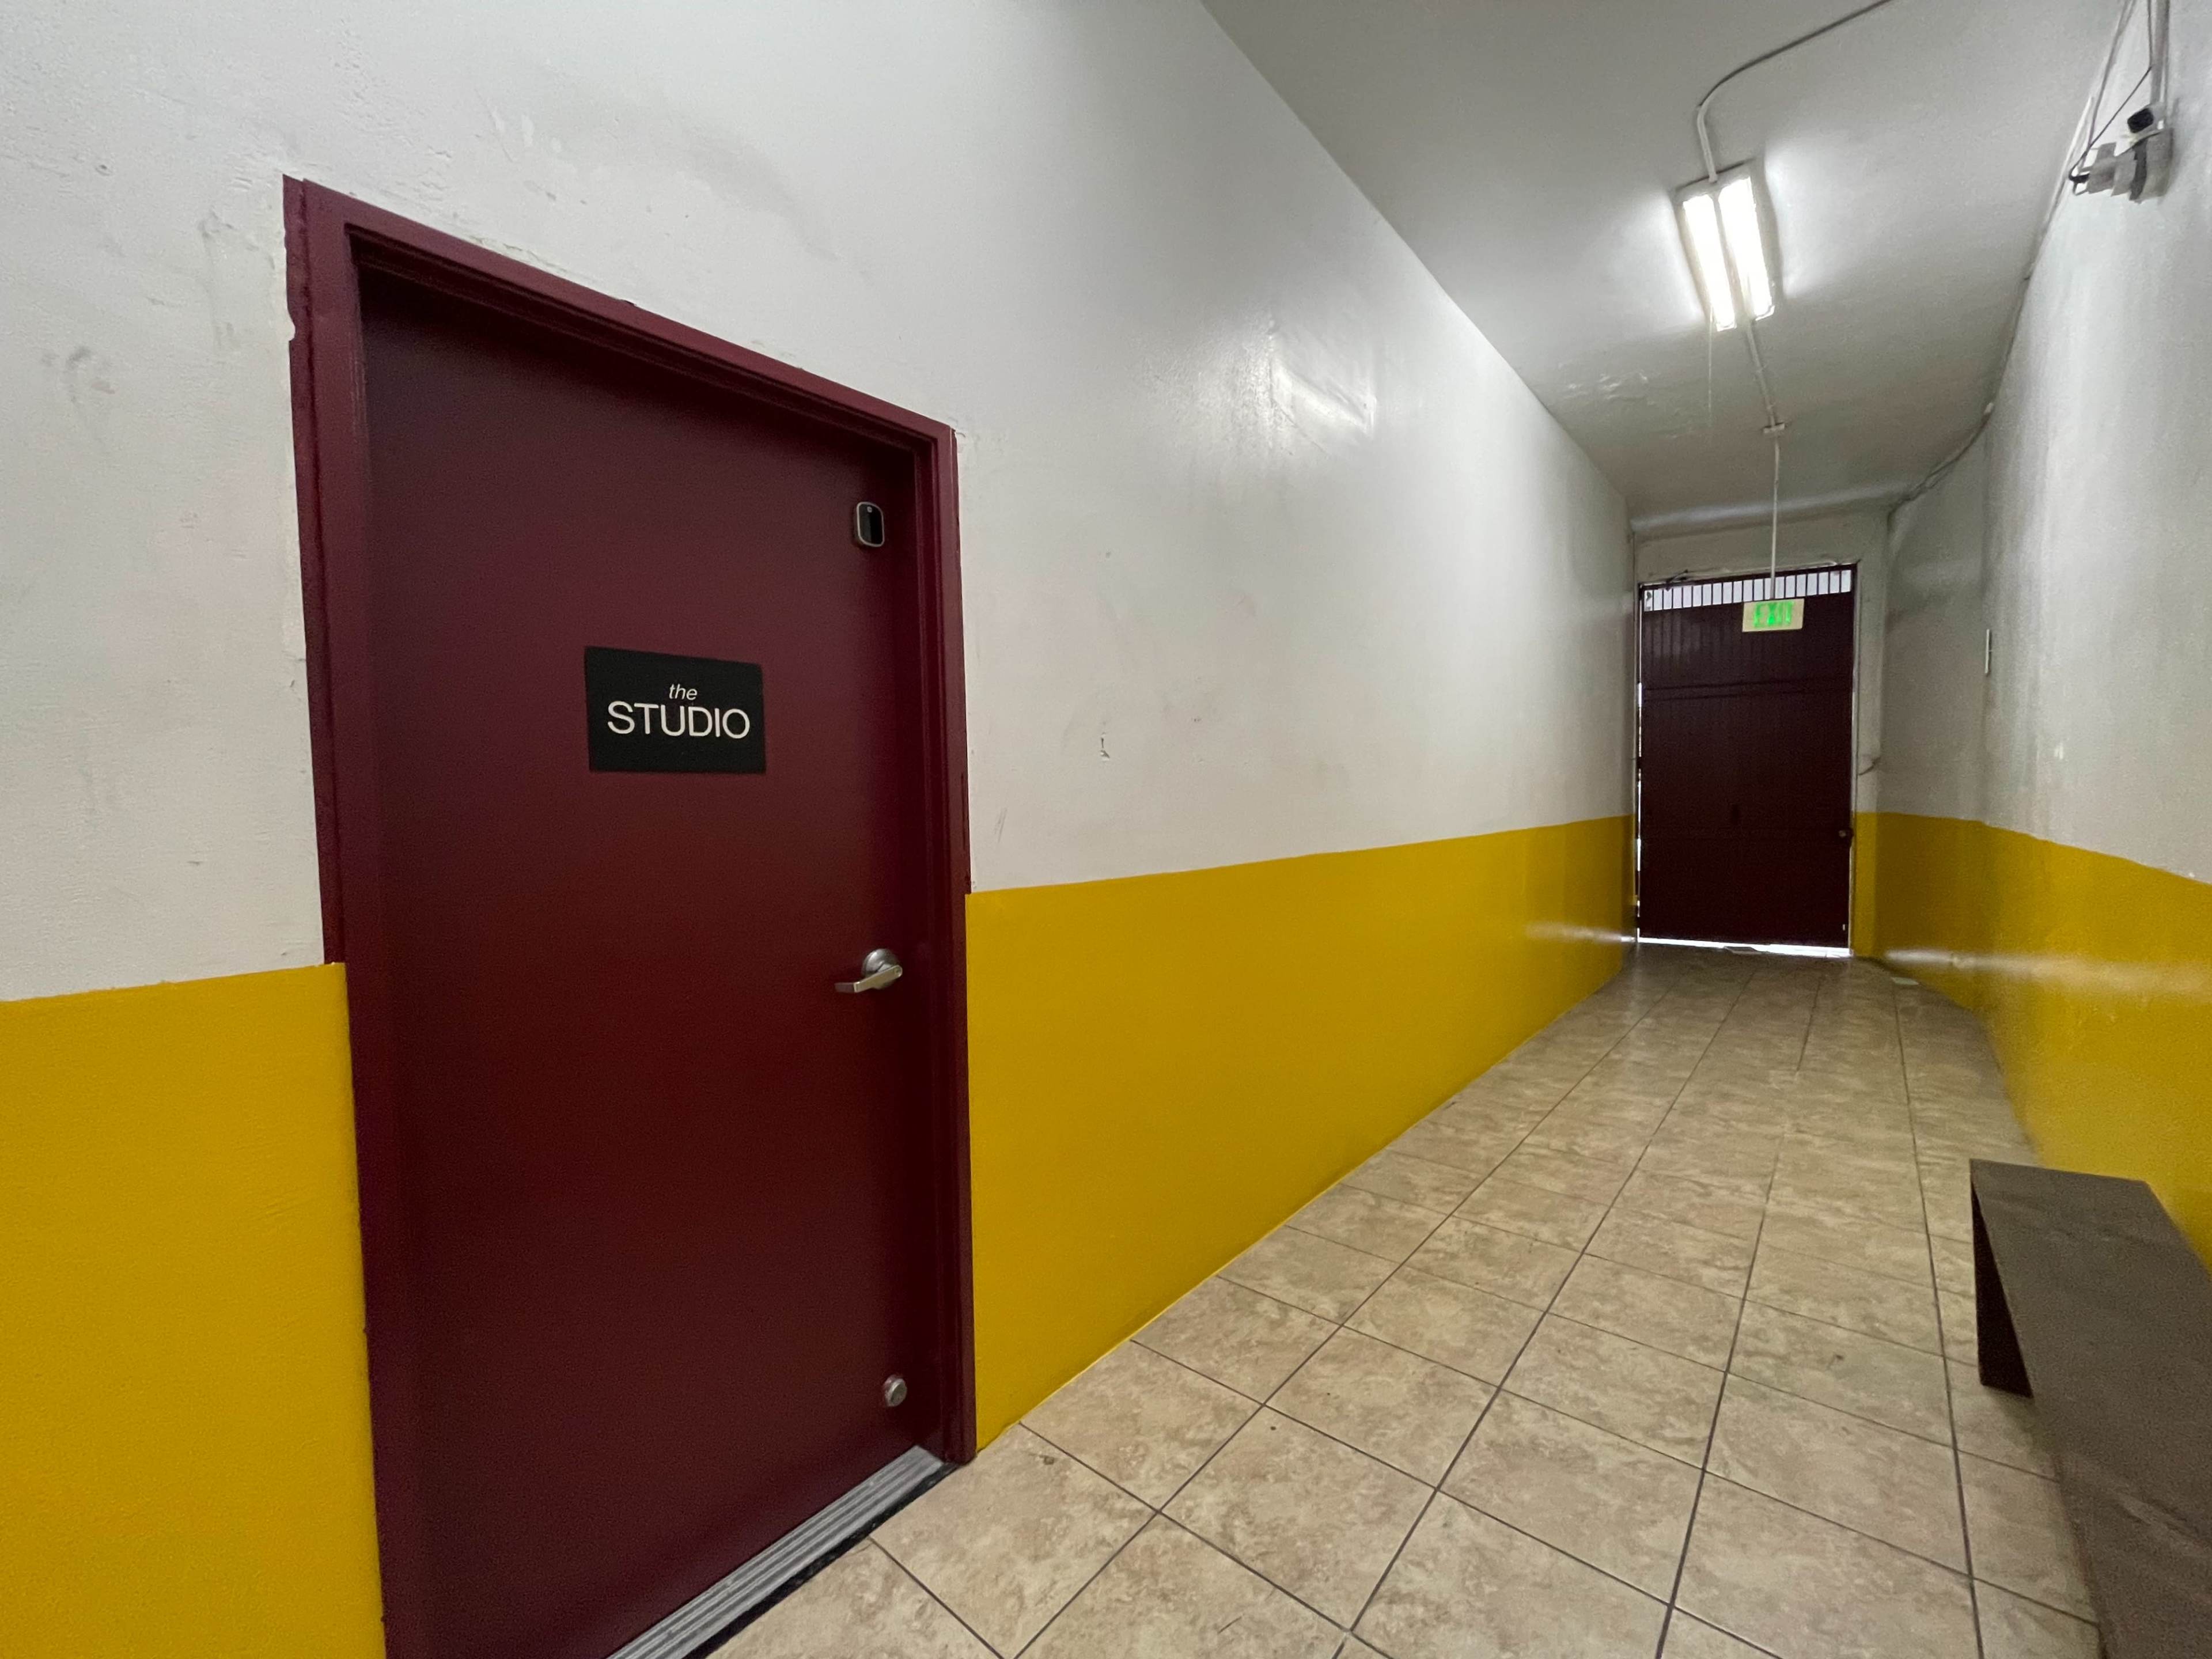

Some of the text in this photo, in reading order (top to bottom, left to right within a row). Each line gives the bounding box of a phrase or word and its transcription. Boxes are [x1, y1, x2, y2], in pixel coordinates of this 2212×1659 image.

[1753, 601, 1794, 628] EXIT
[669, 684, 698, 700] the
[607, 700, 750, 739] STUDIO
